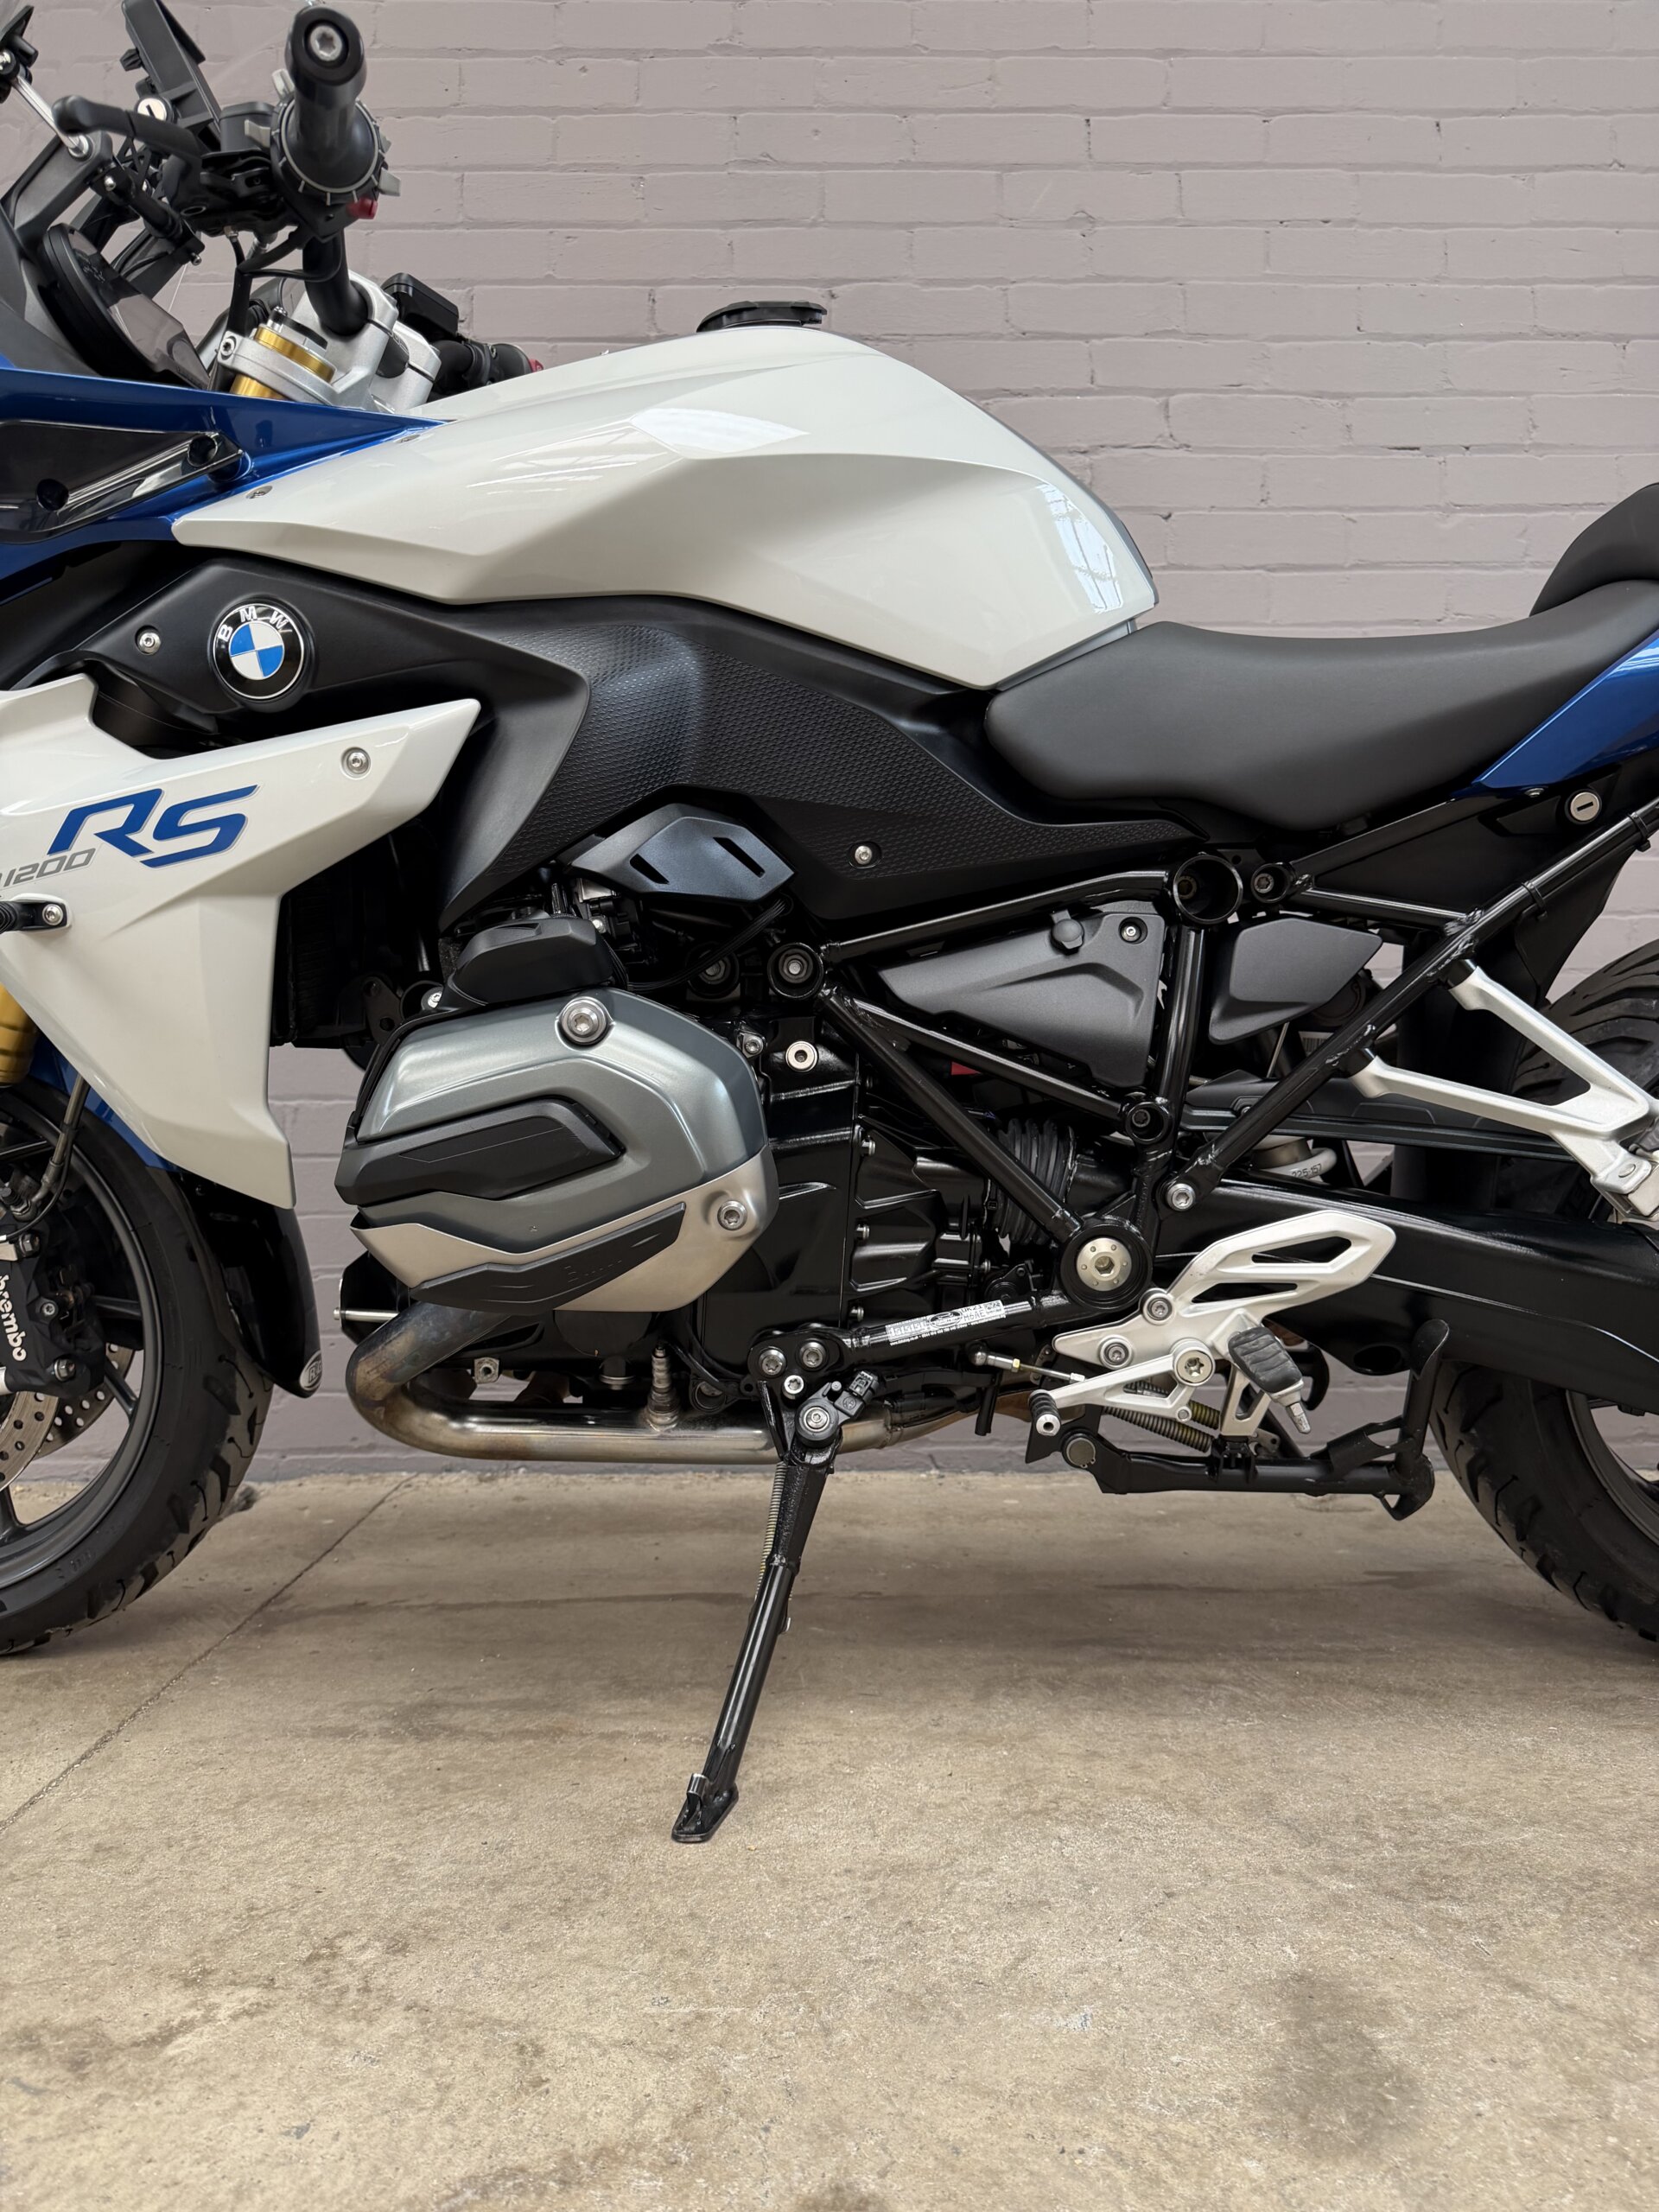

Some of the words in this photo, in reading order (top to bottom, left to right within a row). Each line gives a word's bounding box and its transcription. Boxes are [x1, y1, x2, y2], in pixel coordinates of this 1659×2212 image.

[218, 606, 289, 642] BMW
[48, 785, 258, 868] RS
[3, 848, 96, 887] 1200
